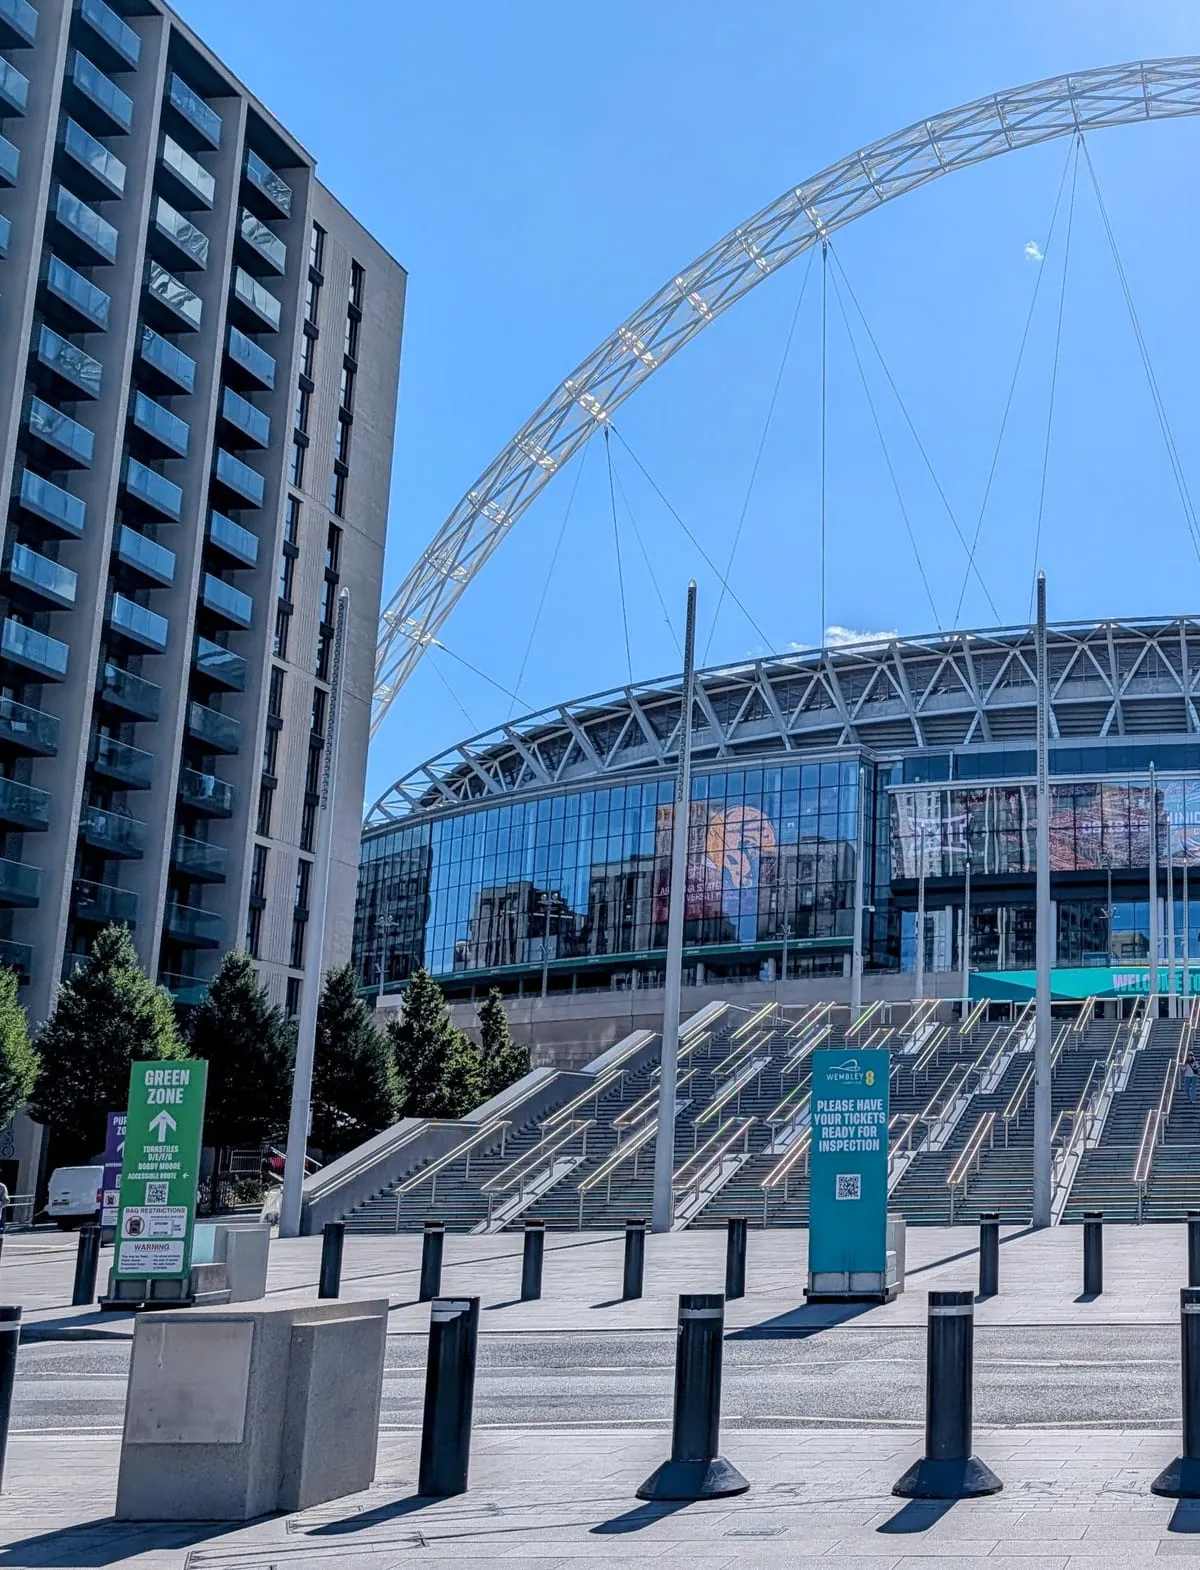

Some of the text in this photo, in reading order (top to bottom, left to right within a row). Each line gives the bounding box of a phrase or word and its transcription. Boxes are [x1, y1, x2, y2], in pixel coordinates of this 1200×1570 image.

[145, 1069, 190, 1086] GREEN
[826, 1072, 864, 1081] WEMBLEY
[147, 1088, 184, 1105] ZONE
[817, 1099, 883, 1112] PLEASE HAVE
[814, 1112, 886, 1126] YOUR TICKETS
[822, 1126, 878, 1139] READY FOR
[143, 1145, 179, 1153] TURNSTILES
[818, 1139, 880, 1152] INSPECTION
[138, 1162, 181, 1170] BOBBY MOORE
[128, 1172, 177, 1180] ACCESSIBLE ROUTE
[134, 1243, 170, 1251] WARNING
